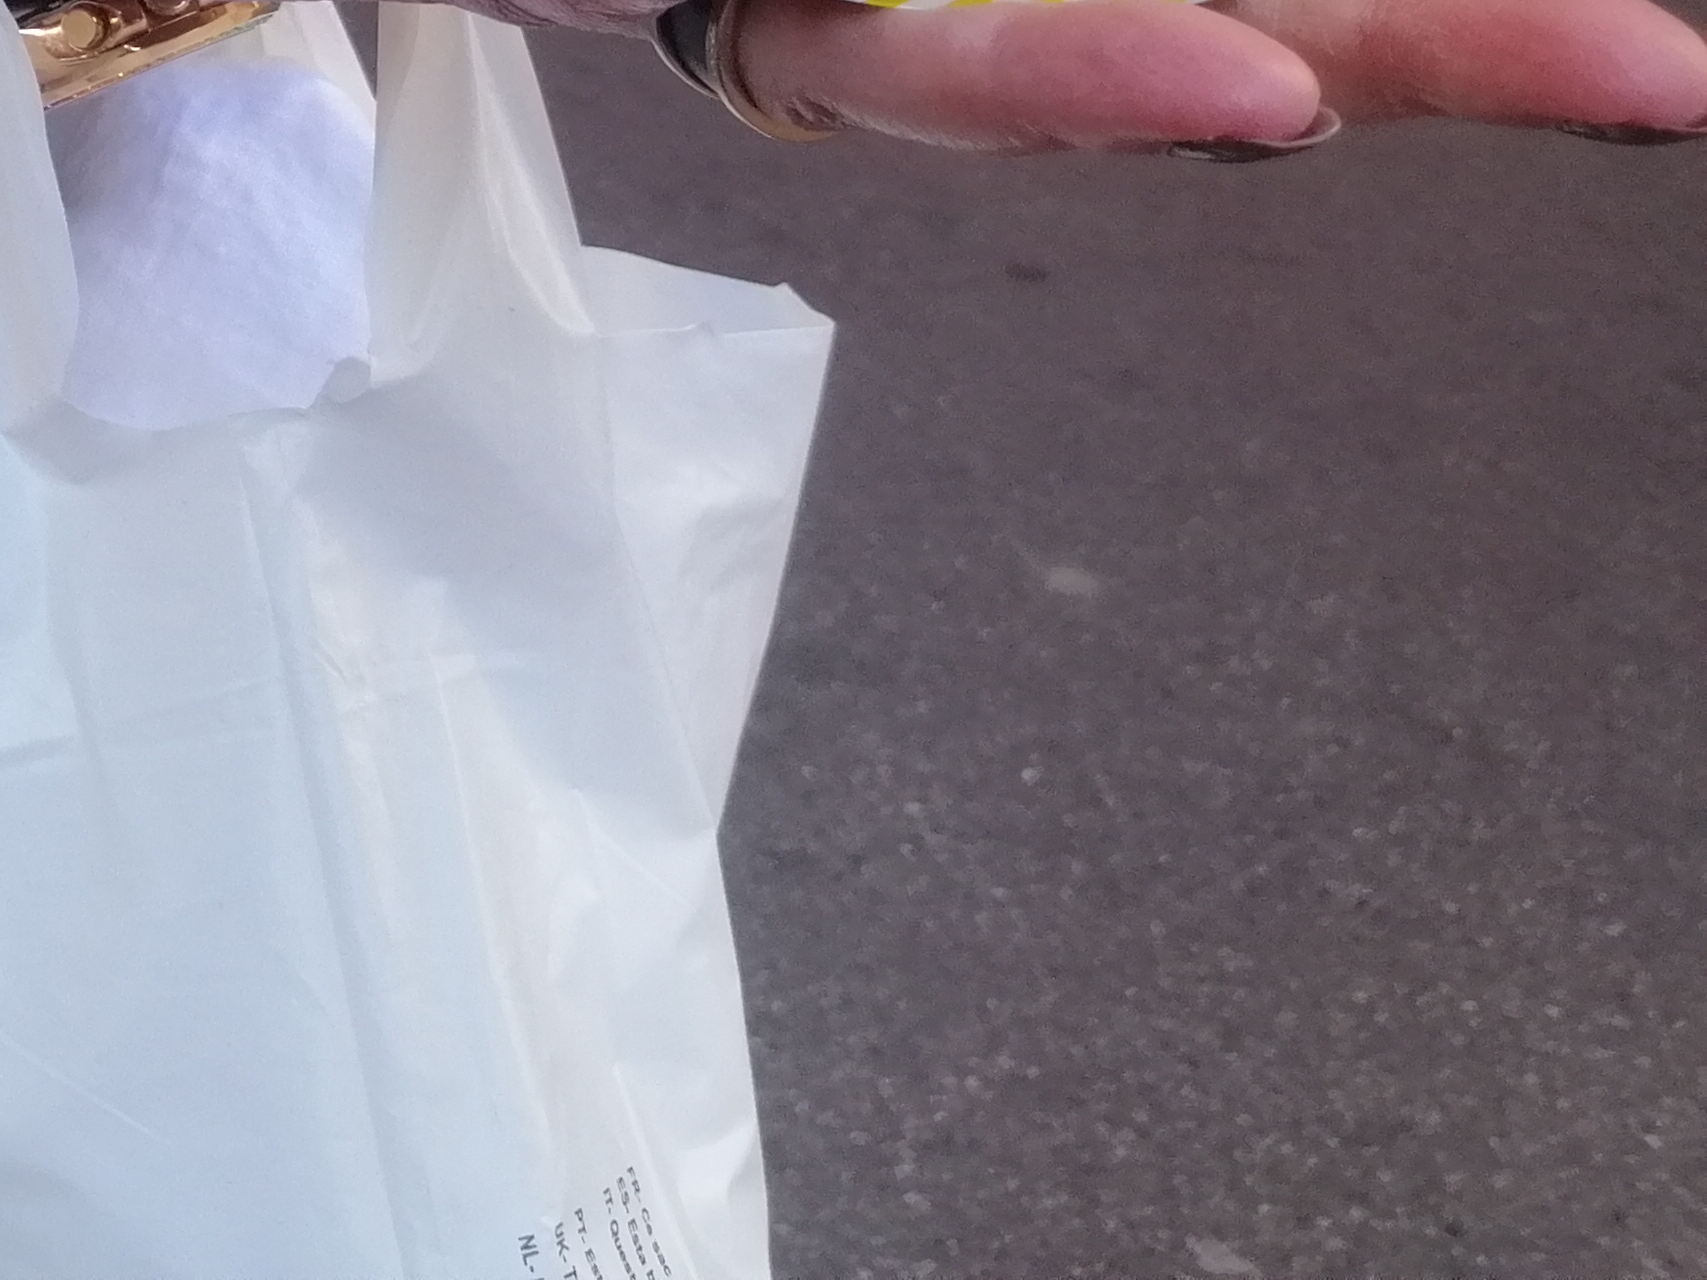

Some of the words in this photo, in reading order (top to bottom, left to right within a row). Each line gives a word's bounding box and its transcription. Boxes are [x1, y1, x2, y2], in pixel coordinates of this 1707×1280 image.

[602, 1187, 614, 1216] IT-
[615, 1176, 630, 1215] ES-
[627, 1218, 647, 1267] Esta
[626, 1166, 641, 1204] FR-
[640, 1207, 653, 1237] Ce
[651, 1240, 673, 1278] sac
[554, 1221, 570, 1264] UK-
[574, 1207, 588, 1244] PT-
[517, 1233, 540, 1274] NL-
